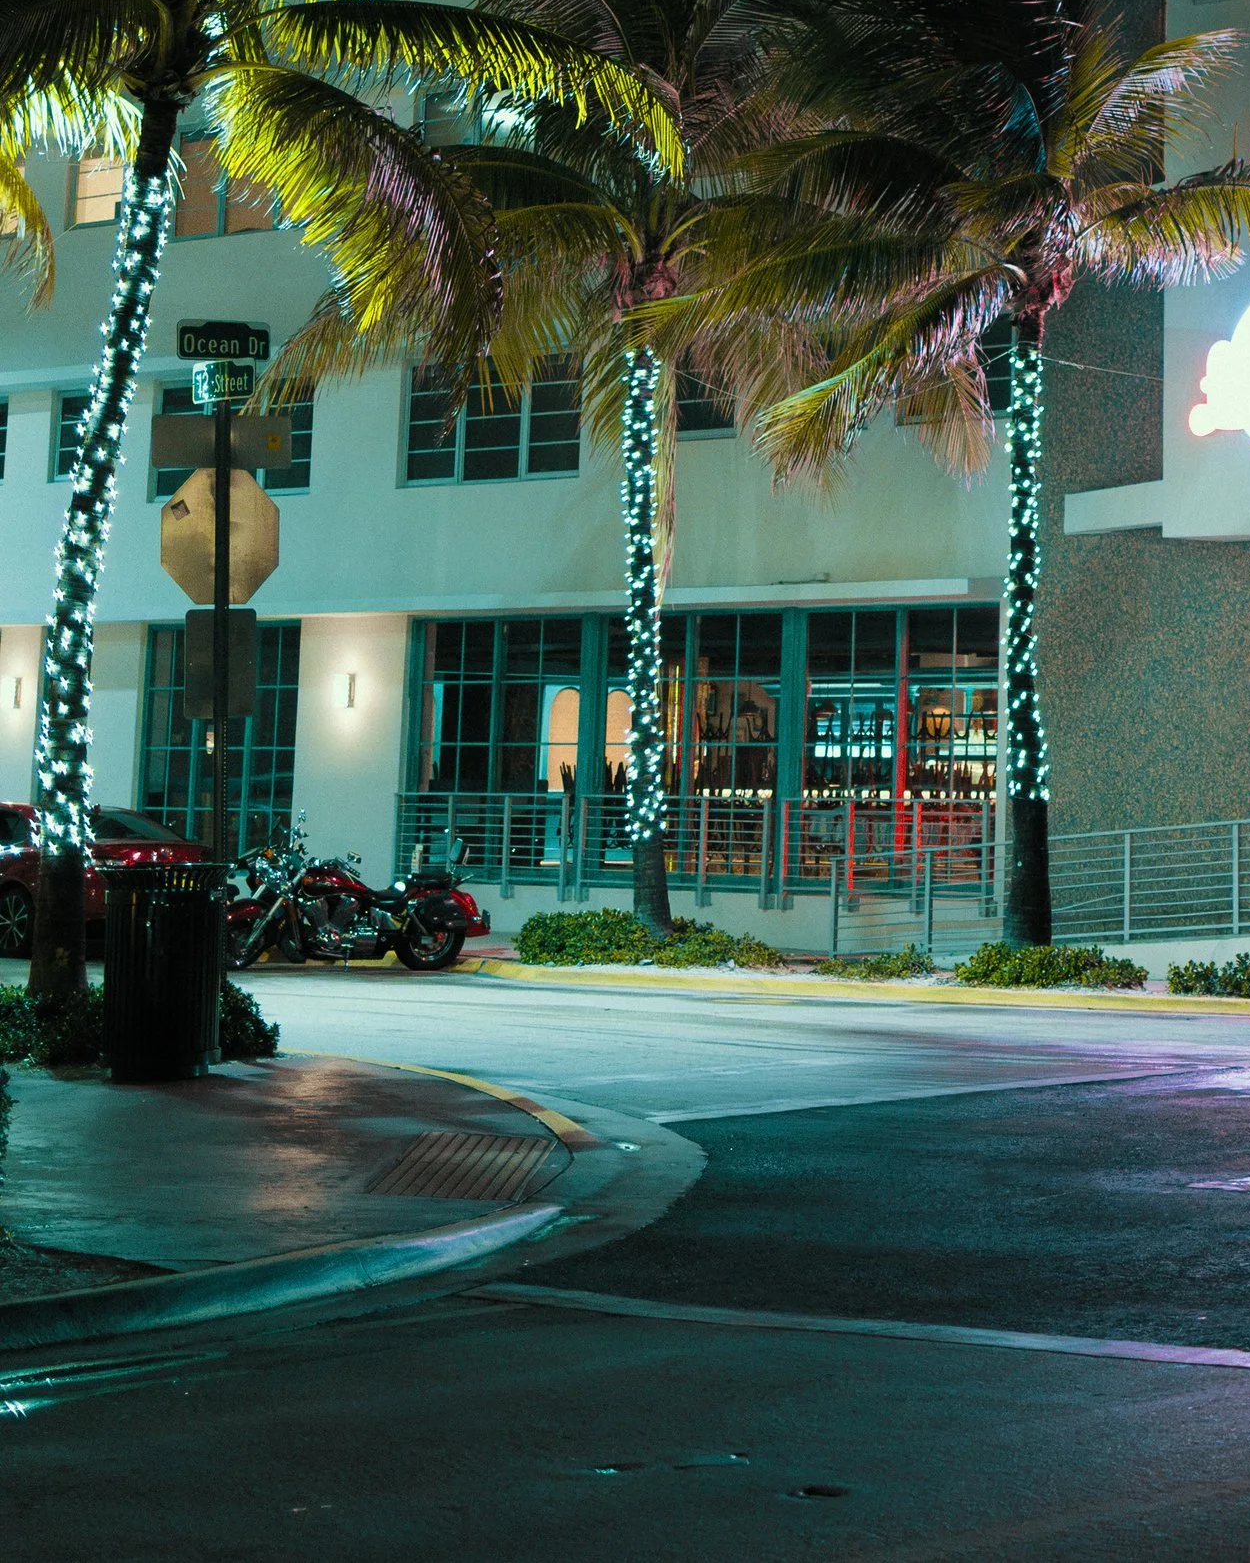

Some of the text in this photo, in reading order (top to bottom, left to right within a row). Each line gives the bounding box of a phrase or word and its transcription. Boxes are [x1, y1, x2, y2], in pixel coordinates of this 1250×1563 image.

[183, 333, 266, 356] Ocean Dr
[196, 370, 249, 399] 12 Street
